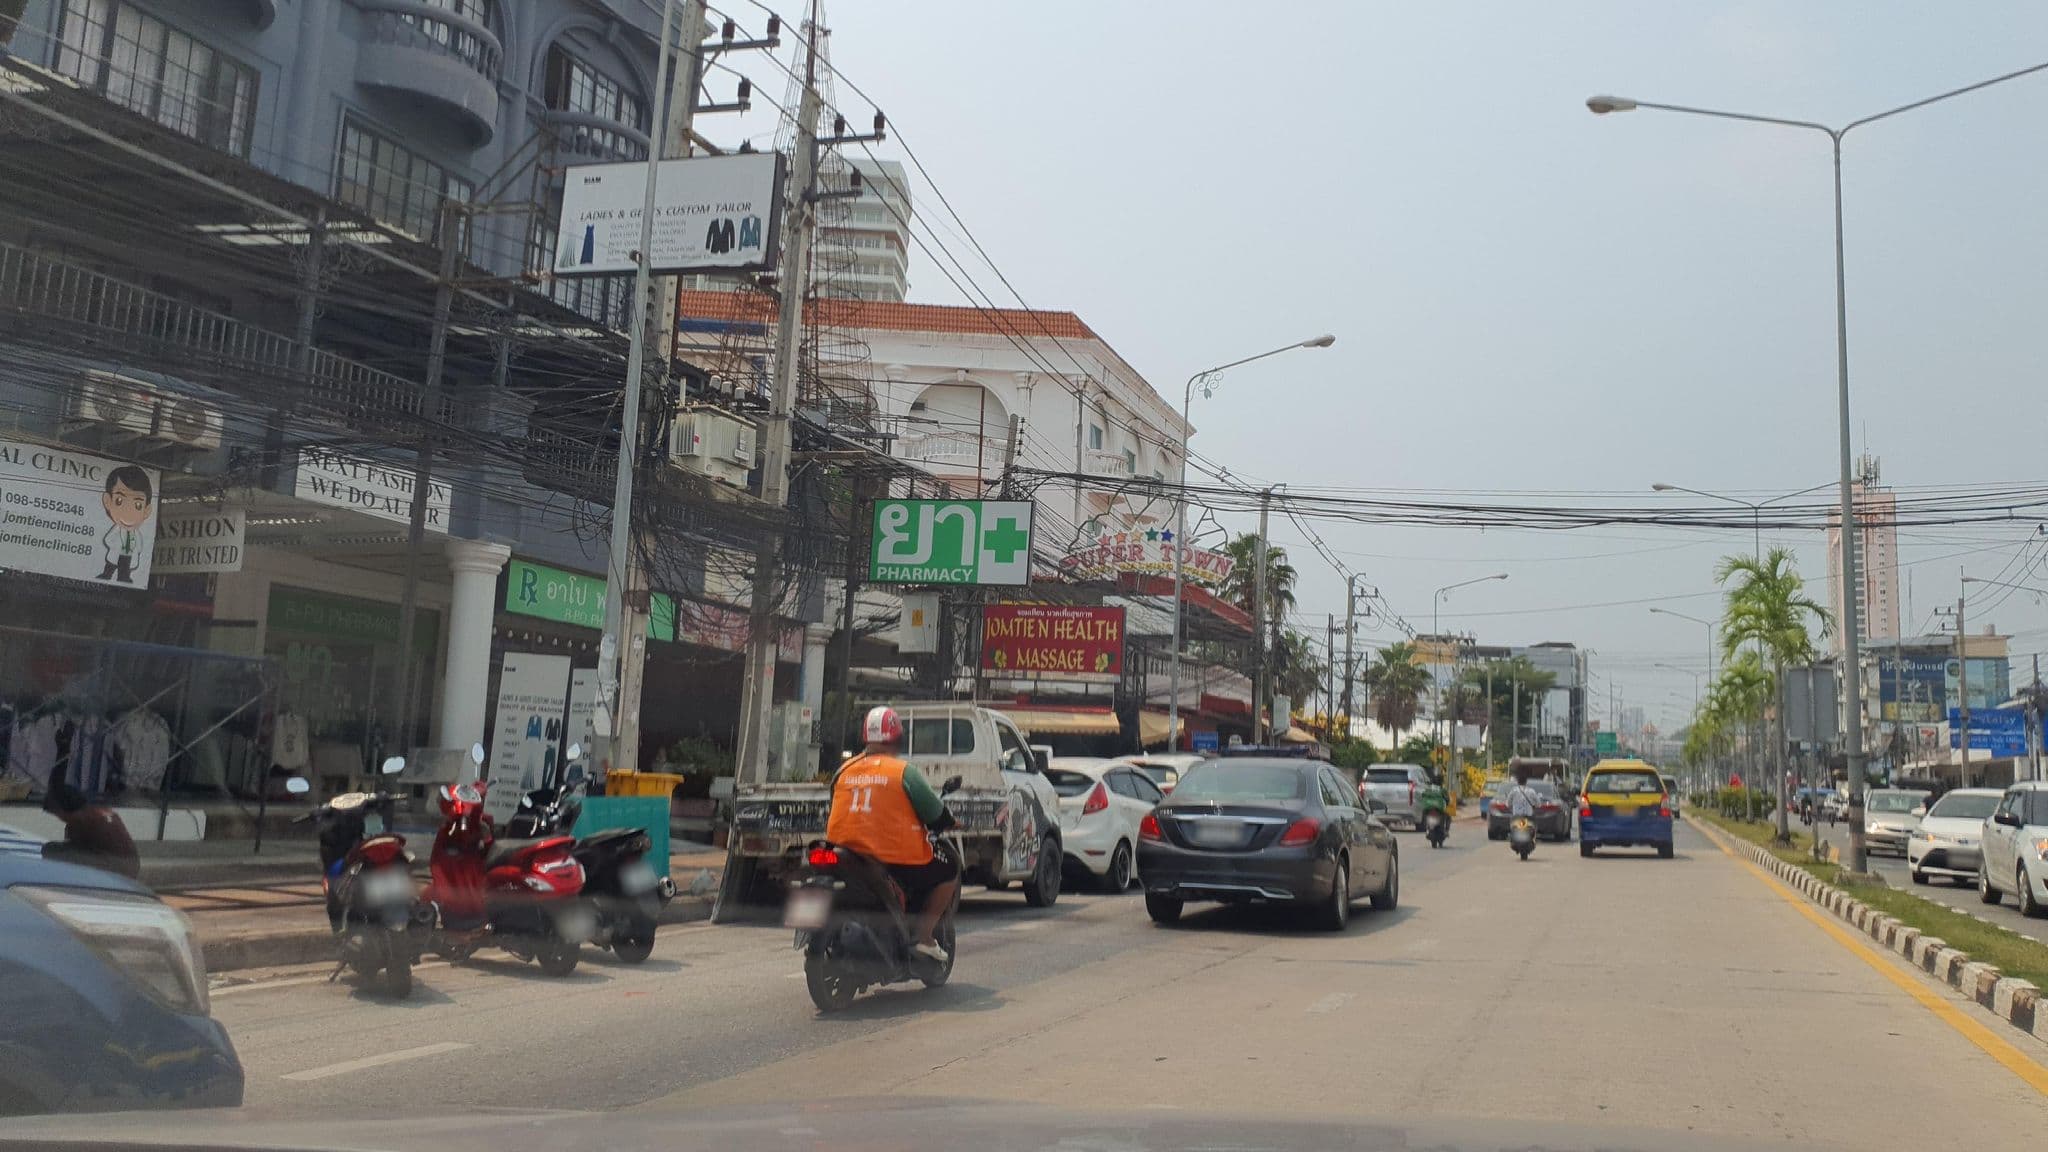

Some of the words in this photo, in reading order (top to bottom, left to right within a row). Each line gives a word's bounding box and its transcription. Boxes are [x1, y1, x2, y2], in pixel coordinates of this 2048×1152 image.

[580, 209, 613, 221] LADIES
[618, 208, 625, 219] &
[630, 206, 662, 218] GES
[666, 203, 711, 217] CUSTOM
[715, 202, 752, 213] TAILOR
[32, 451, 102, 482] CLINIC
[307, 451, 361, 479] NEXT
[367, 466, 443, 501] FASHON
[6, 490, 85, 516] 098-5552348
[311, 475, 343, 500] WE
[349, 486, 376, 508] DO
[381, 495, 439, 525] ALTR
[3, 509, 96, 537] jomtienclinic88
[156, 516, 237, 538] ASHION
[878, 503, 977, 566] ยา
[0, 530, 93, 556] jomtienclinic88
[180, 545, 238, 566] TRUSTED
[1160, 543, 1233, 576] TOWN
[876, 566, 973, 582] PHARMACY
[986, 616, 1049, 641] JOMTIEN
[1054, 618, 1118, 642] HEALTH
[1016, 647, 1085, 670] MASSAGE
[849, 786, 872, 813] 11
